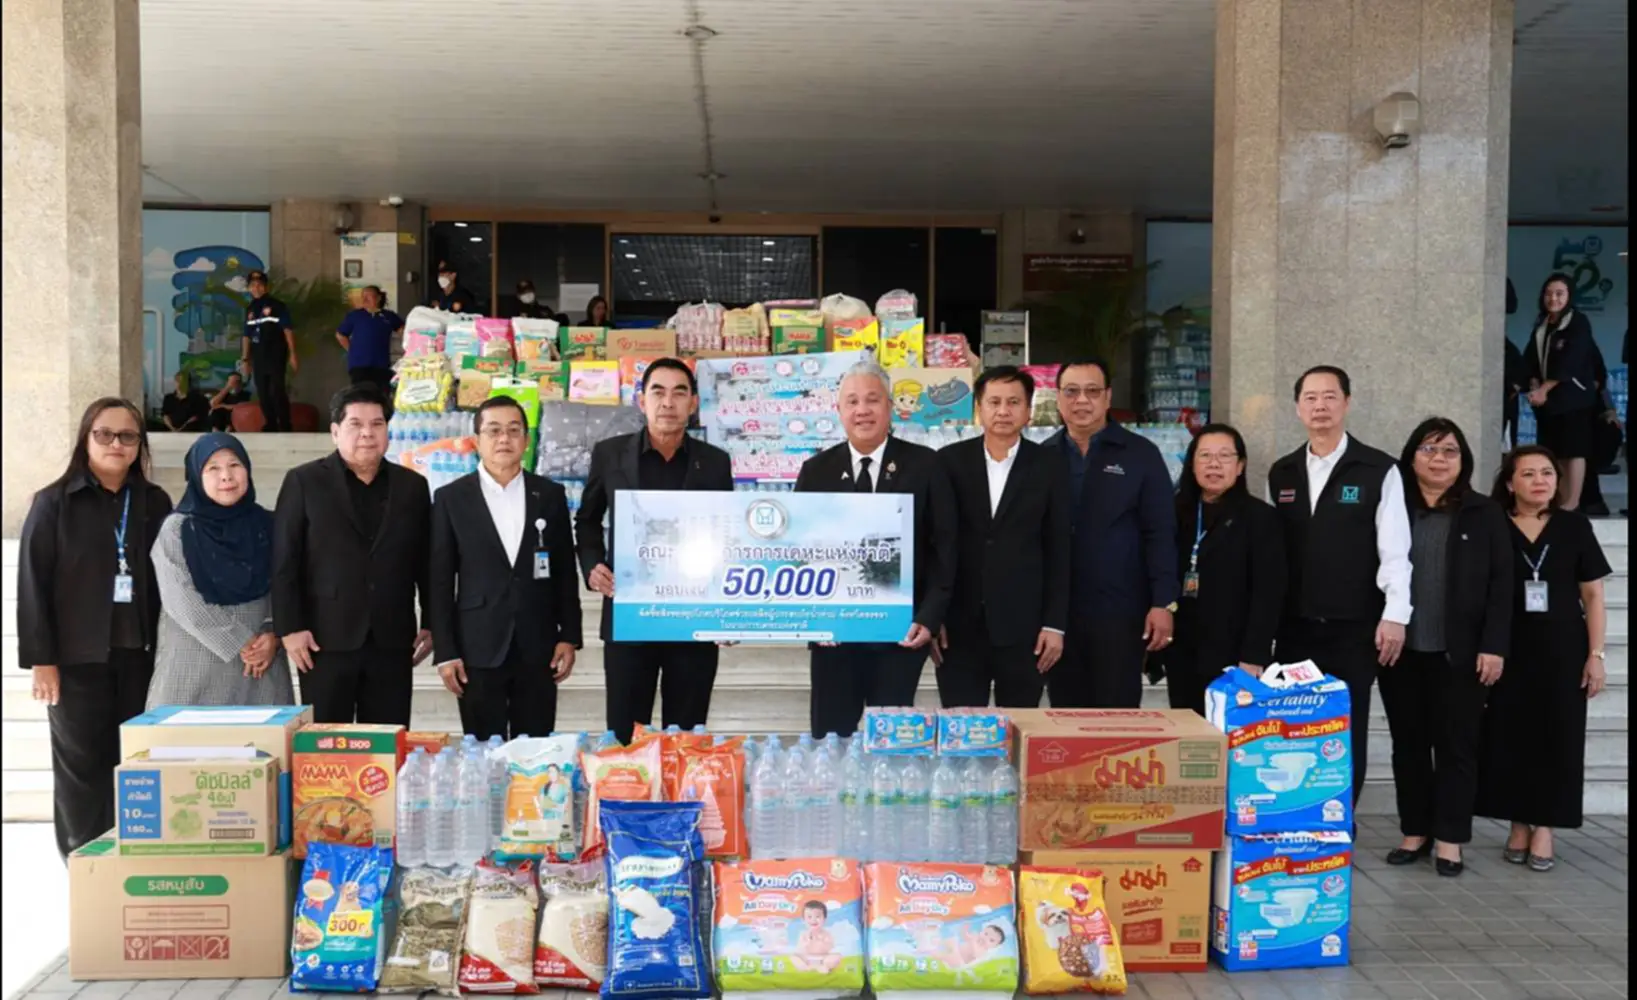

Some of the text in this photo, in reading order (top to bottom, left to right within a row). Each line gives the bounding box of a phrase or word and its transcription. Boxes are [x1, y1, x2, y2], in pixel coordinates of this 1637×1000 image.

[638, 540, 892, 562] คณะการการเคหะแห่งชาติ
[721, 566, 838, 600] 50,000
[847, 584, 875, 598] บาท
[336, 736, 347, 749] 3
[301, 764, 350, 780] MAMA
[122, 807, 142, 819] 10
[147, 876, 205, 895] รสหมูสับ
[743, 870, 825, 892] MamyPoko
[898, 870, 976, 893] MamyPoko
[329, 919, 357, 932] 300
